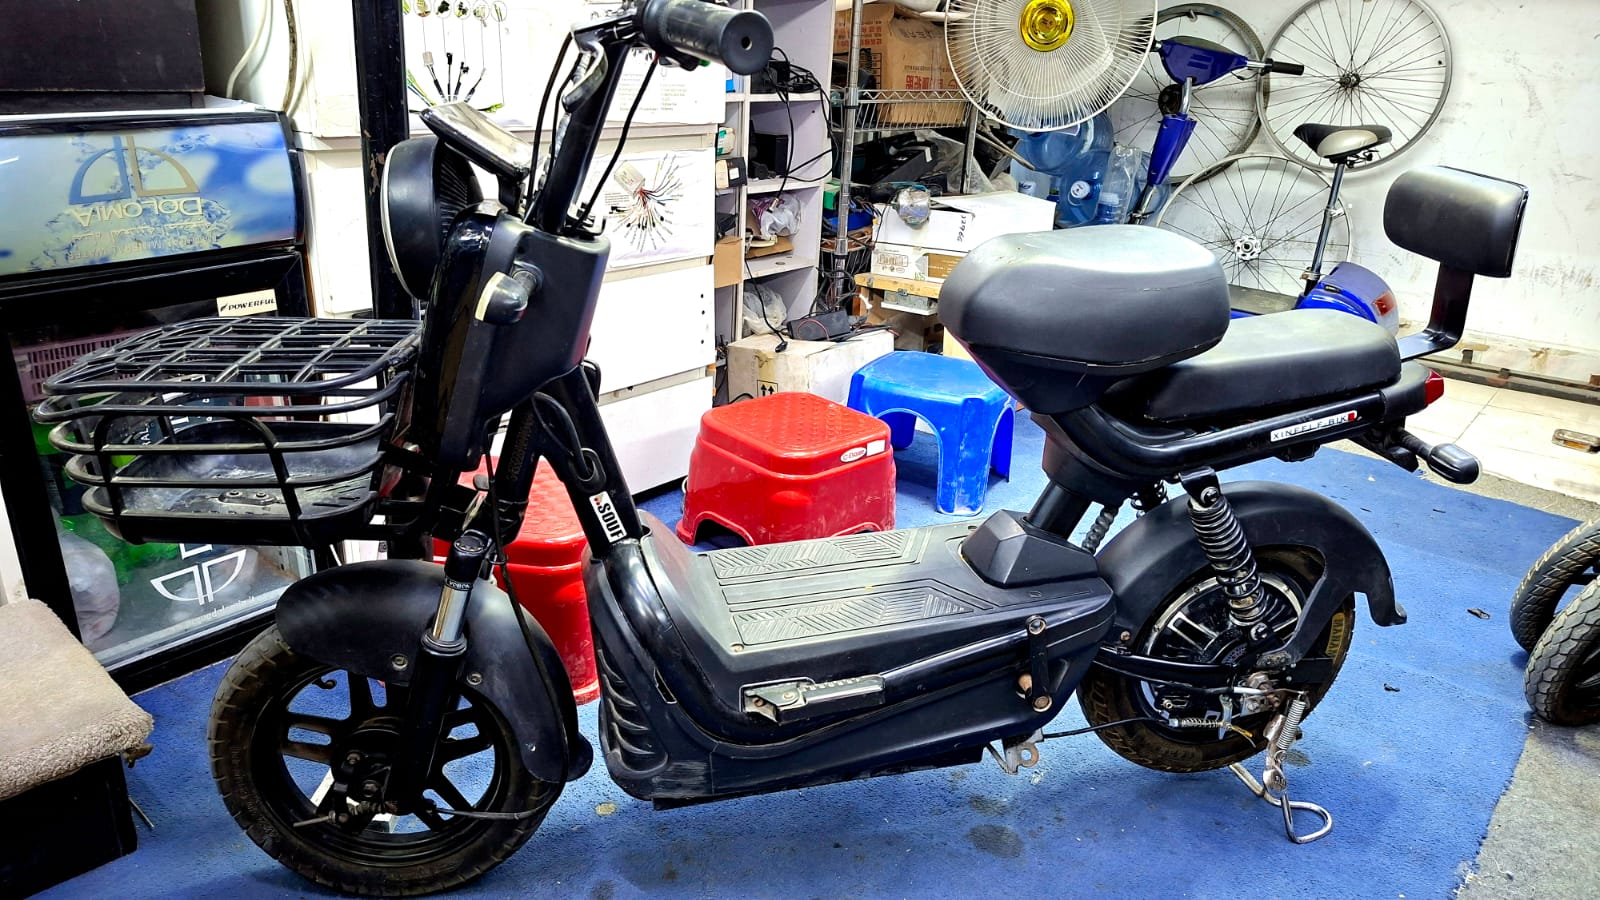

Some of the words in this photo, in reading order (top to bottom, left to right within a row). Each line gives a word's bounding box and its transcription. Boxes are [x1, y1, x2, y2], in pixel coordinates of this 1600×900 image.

[65, 197, 203, 227] DOLOMIA
[70, 249, 106, 261] WATER
[228, 299, 275, 311] POWERFUL
